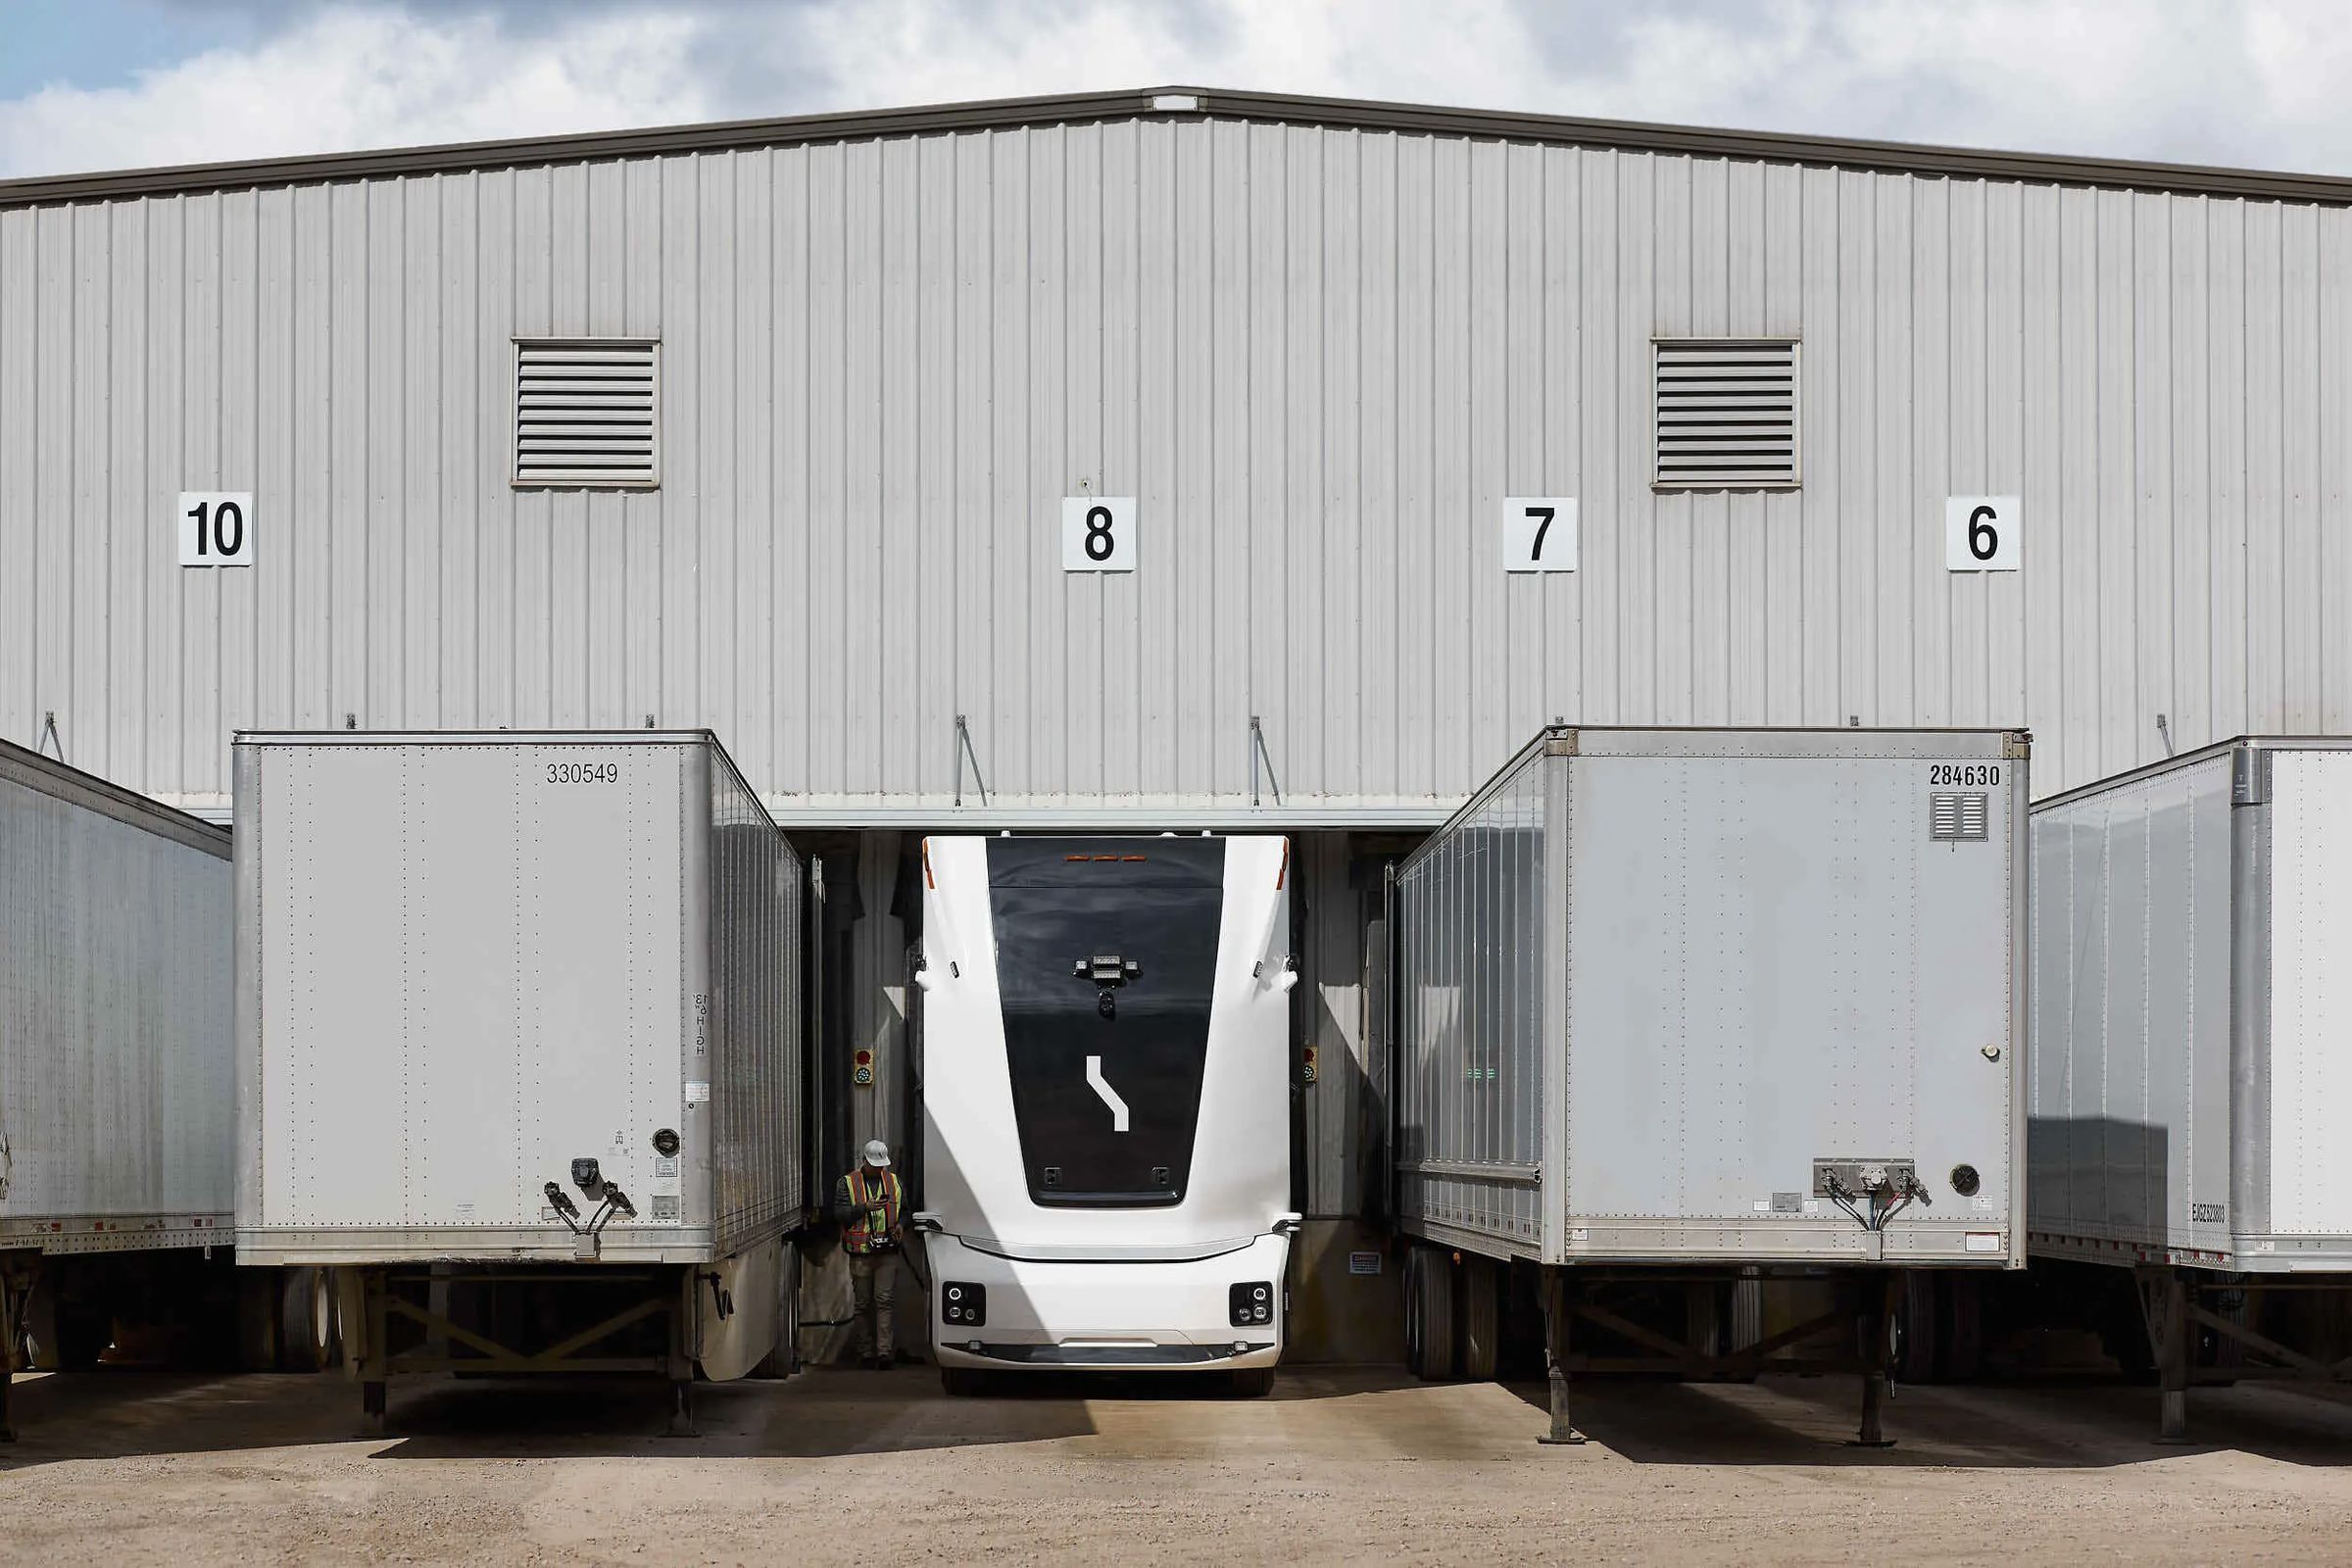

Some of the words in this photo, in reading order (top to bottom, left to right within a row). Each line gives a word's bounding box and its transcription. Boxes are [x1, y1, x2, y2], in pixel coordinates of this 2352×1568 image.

[187, 502, 243, 556] 10
[1085, 506, 1114, 562] 8
[1525, 507, 1555, 561] 7
[1968, 505, 1998, 561] 6
[546, 762, 618, 784] 330549
[1930, 764, 2000, 787] 284630
